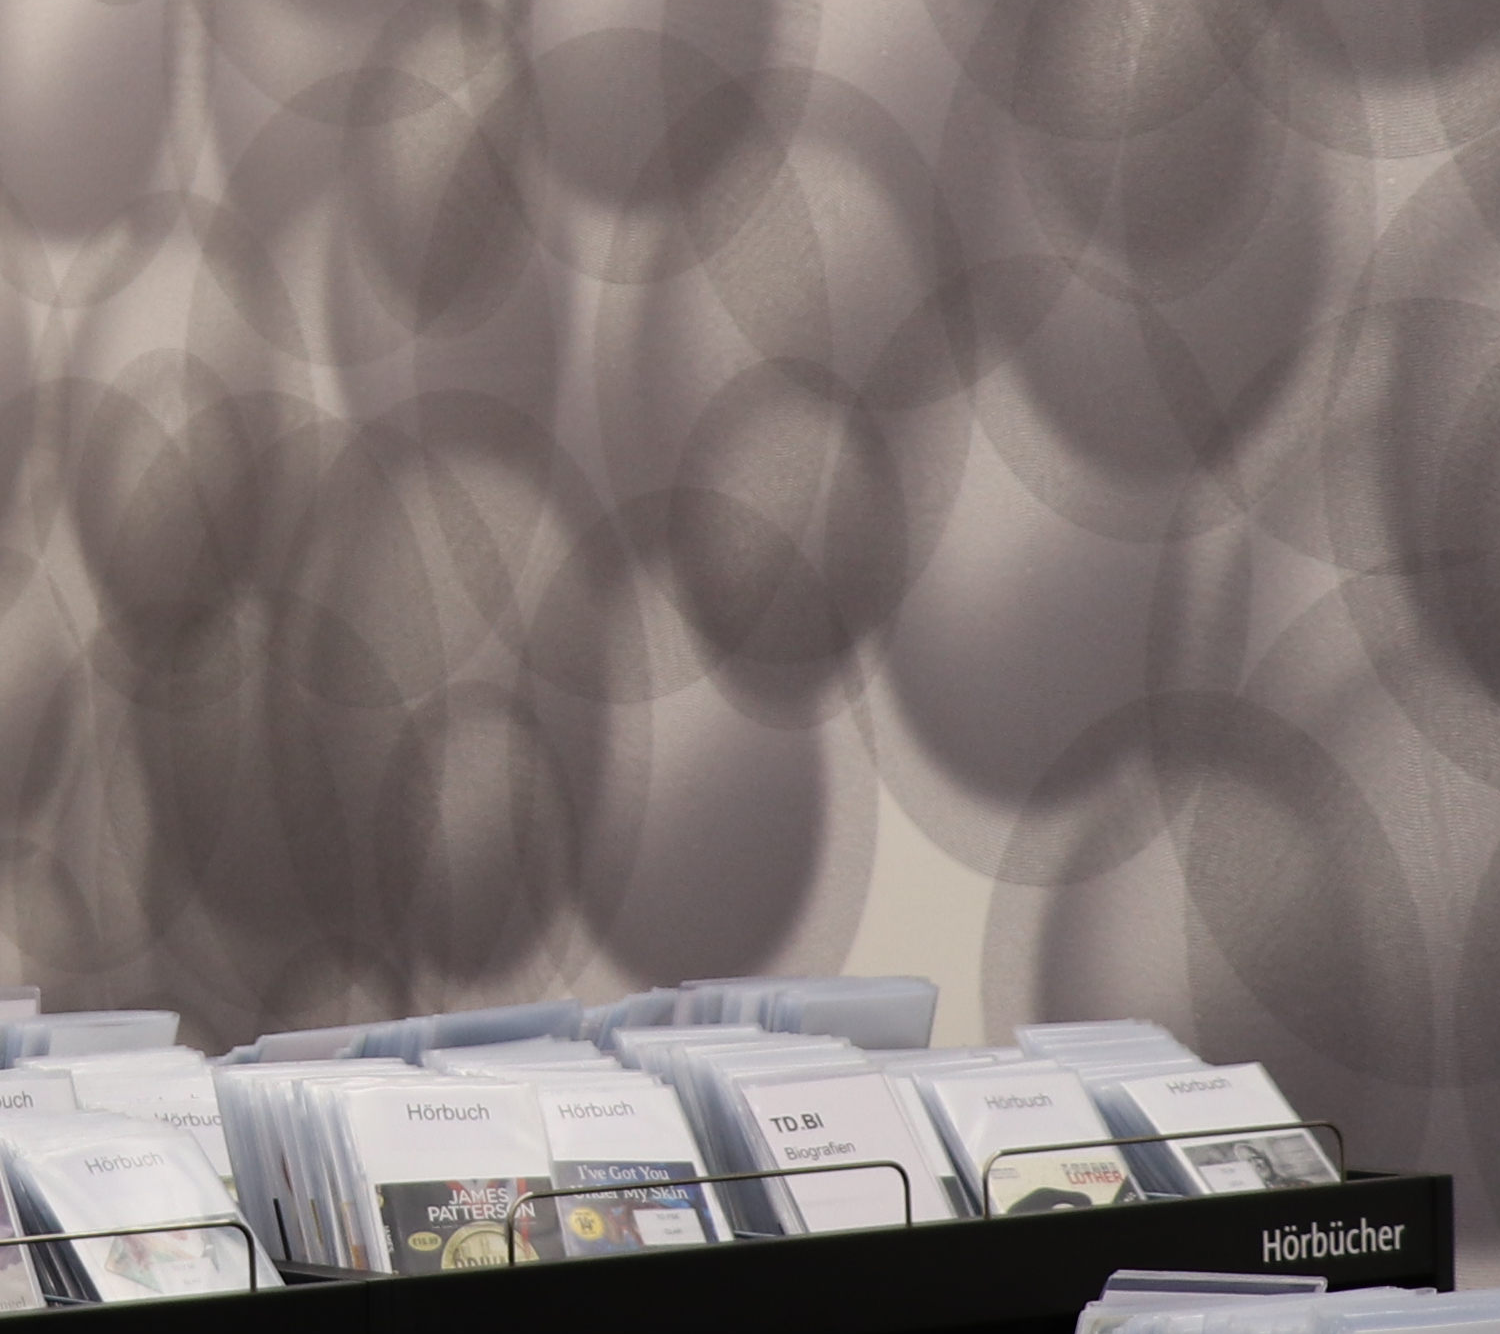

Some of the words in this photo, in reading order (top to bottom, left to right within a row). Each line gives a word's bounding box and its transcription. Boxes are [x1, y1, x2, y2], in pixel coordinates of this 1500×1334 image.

[1166, 1076, 1232, 1095] Hörbuch
[558, 1100, 636, 1119] Hörbuch
[984, 1092, 1054, 1110] Hörbuch
[406, 1103, 490, 1121] Hörbuch
[768, 1112, 824, 1134] TD.BI
[784, 1141, 857, 1161] Biografien
[84, 1150, 165, 1175] Hörbuch
[577, 1164, 607, 1181] I've
[609, 1165, 637, 1181] Got
[638, 1165, 670, 1181] You
[448, 1187, 509, 1205] JAMES
[650, 1185, 690, 1200] Skin
[426, 1201, 537, 1222] PATTERSON
[1262, 1217, 1406, 1263] Hörbücher
